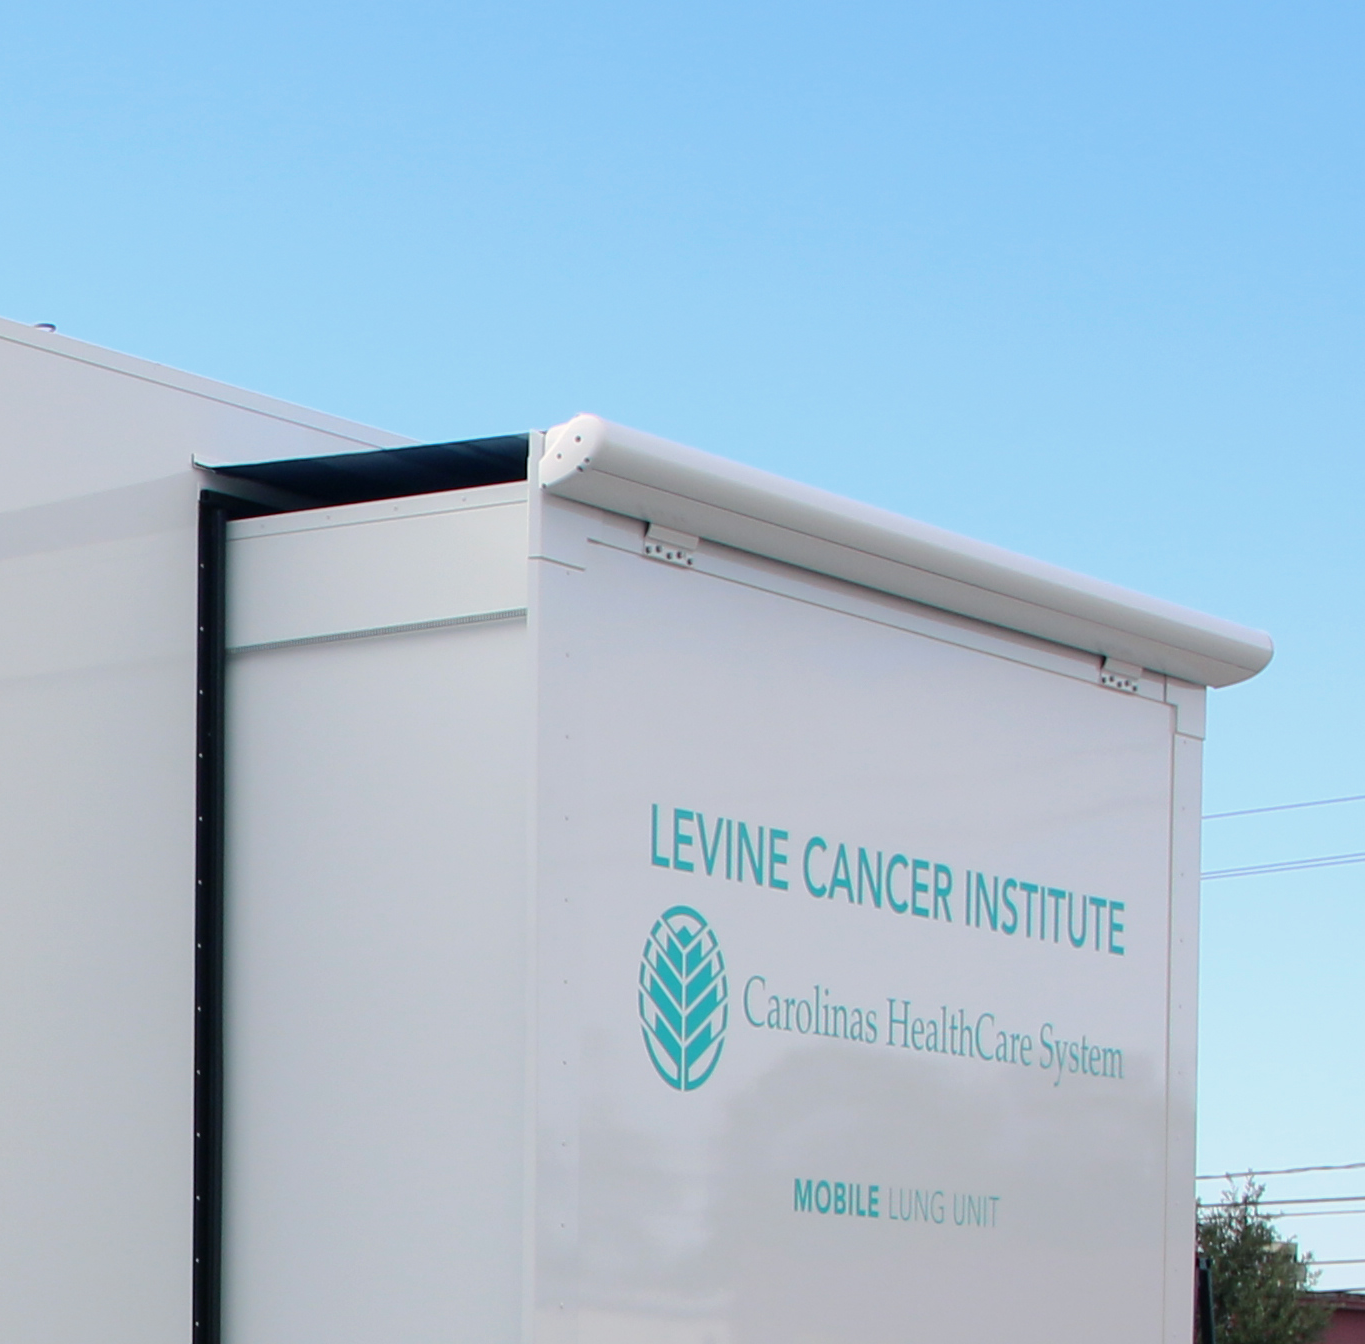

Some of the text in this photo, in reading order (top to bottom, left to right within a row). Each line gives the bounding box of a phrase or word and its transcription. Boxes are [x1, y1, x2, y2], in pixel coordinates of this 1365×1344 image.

[651, 803, 1125, 956] LEVINE CANCER INSTITUTE
[743, 975, 1125, 1087] Carolinas HealthCare System
[793, 1177, 1001, 1228] MOBILE LUNG UNIT
